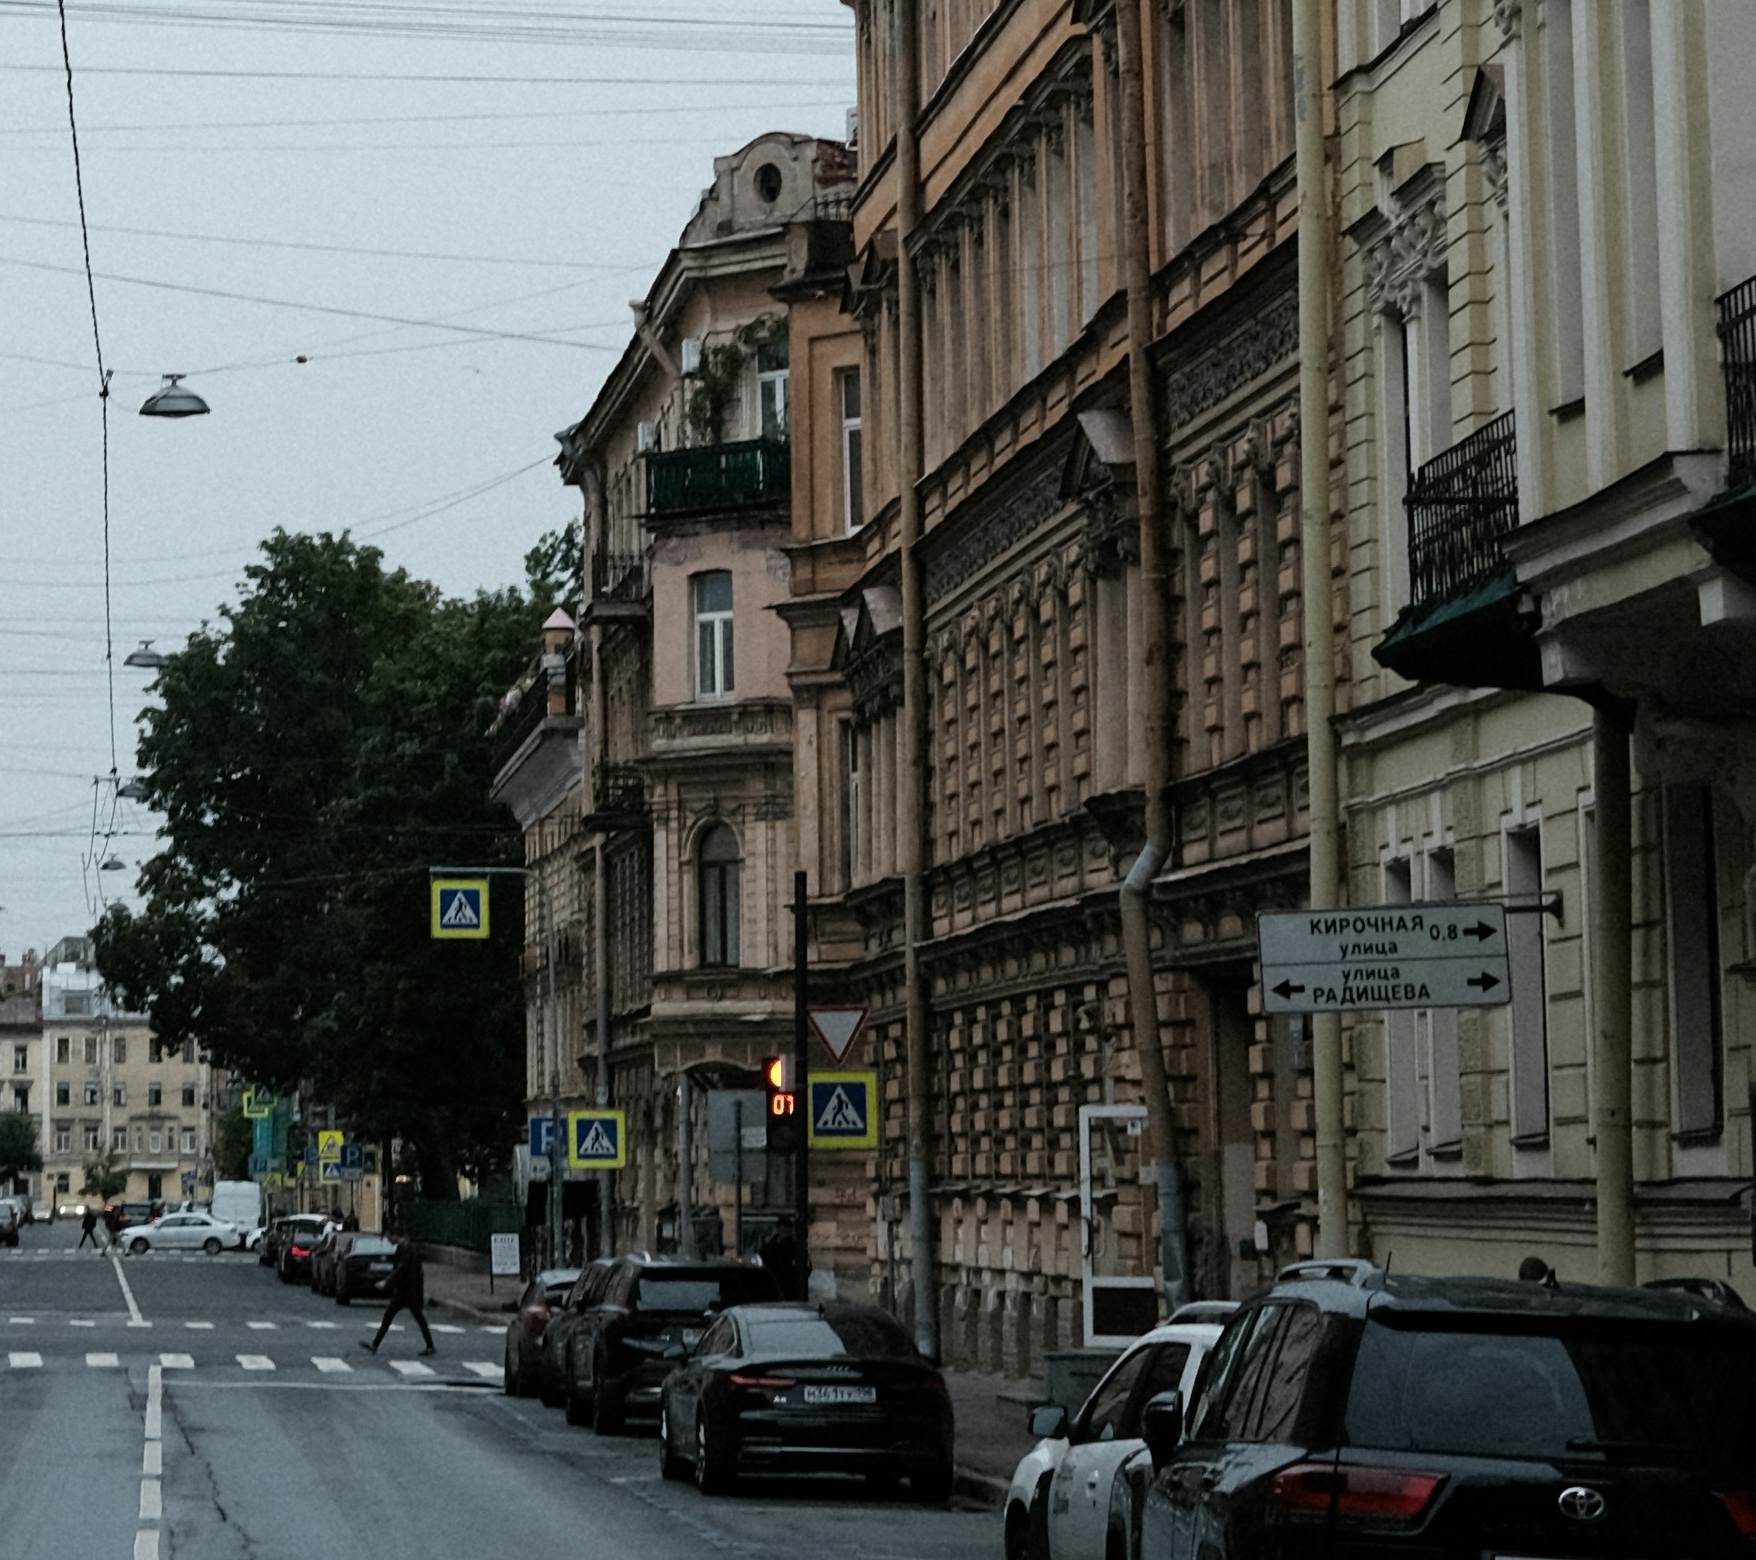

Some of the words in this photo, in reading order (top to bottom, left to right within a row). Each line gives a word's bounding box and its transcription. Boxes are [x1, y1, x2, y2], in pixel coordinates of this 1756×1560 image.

[1310, 915, 1424, 935] КИРОЧНАЯ
[1340, 941, 1398, 959] улица
[1342, 967, 1400, 984] улица
[1313, 983, 1431, 1006] РАДИЩЕВА
